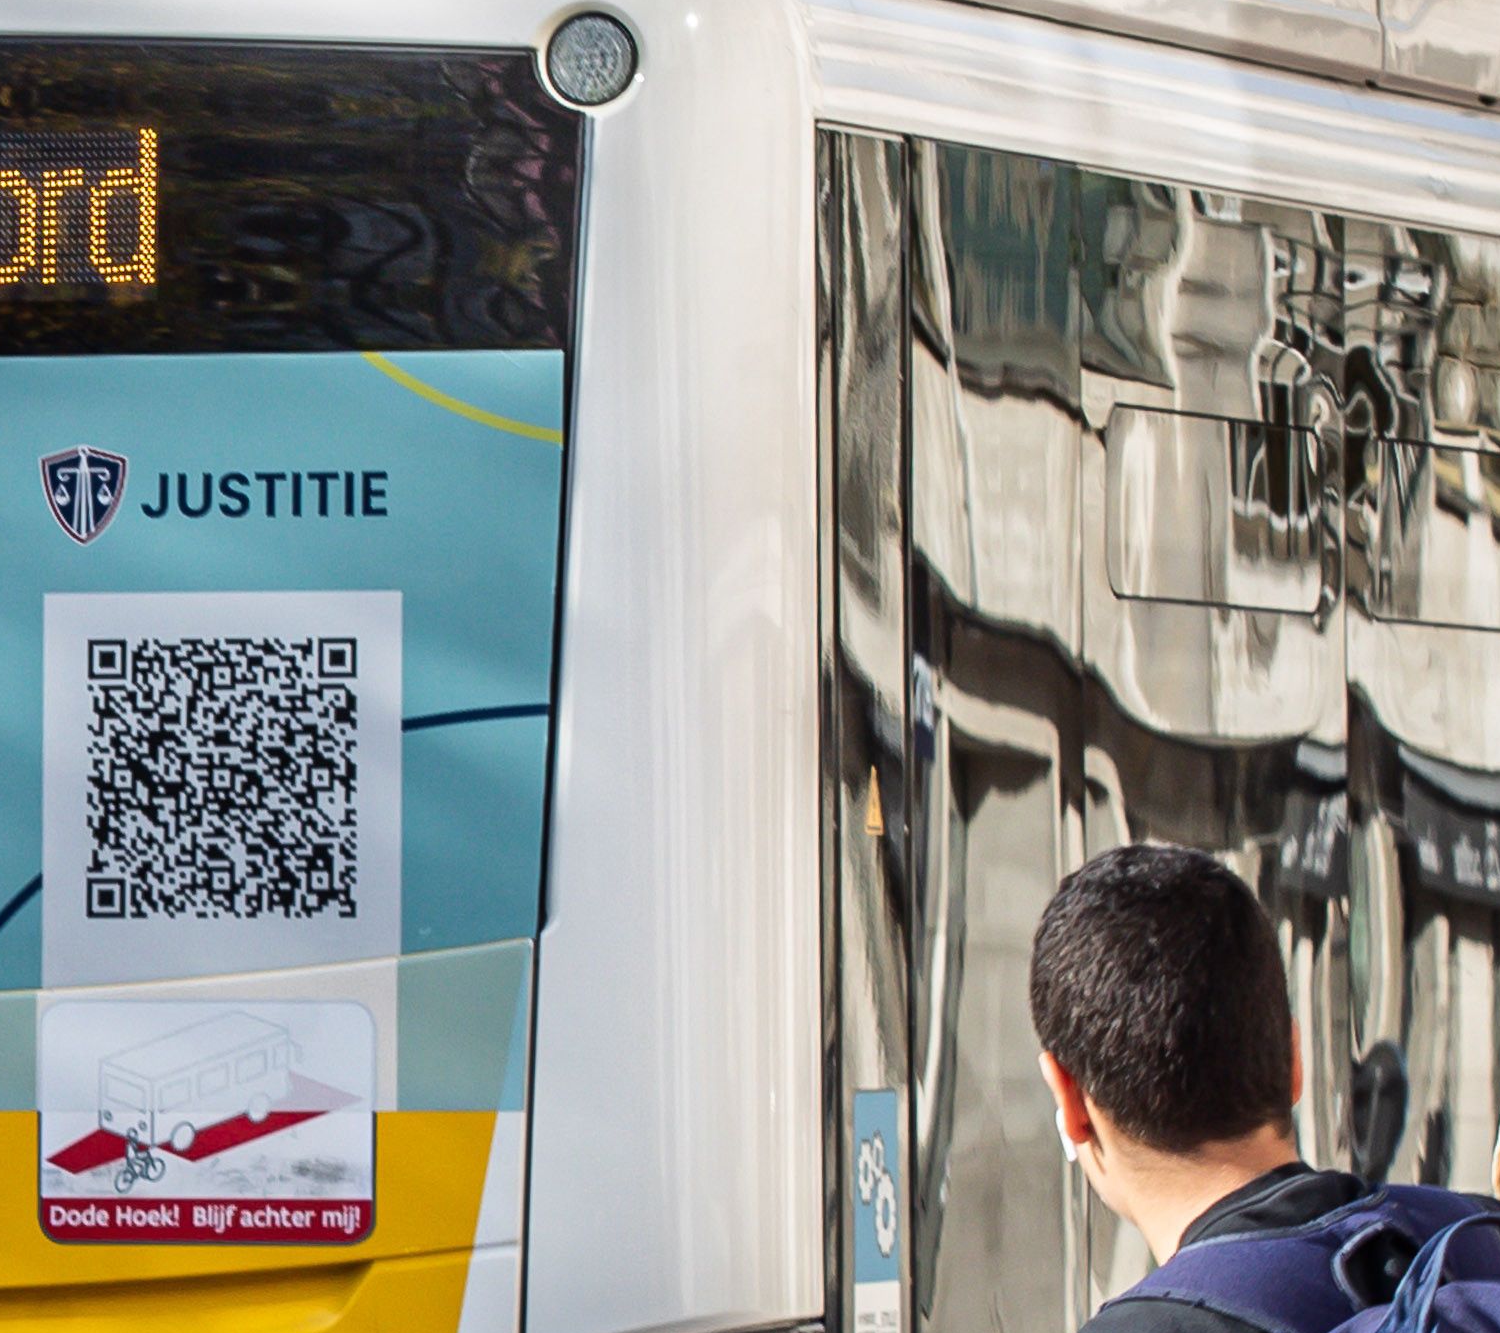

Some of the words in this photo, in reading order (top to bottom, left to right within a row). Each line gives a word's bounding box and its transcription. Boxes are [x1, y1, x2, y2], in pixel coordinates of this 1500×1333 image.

[141, 471, 389, 518] JUSTITIE
[49, 1204, 110, 1228] Dode
[115, 1204, 180, 1228] Hoek!
[192, 1204, 237, 1234] Blijf
[239, 1204, 316, 1228] achter
[321, 1204, 361, 1235] mij!
